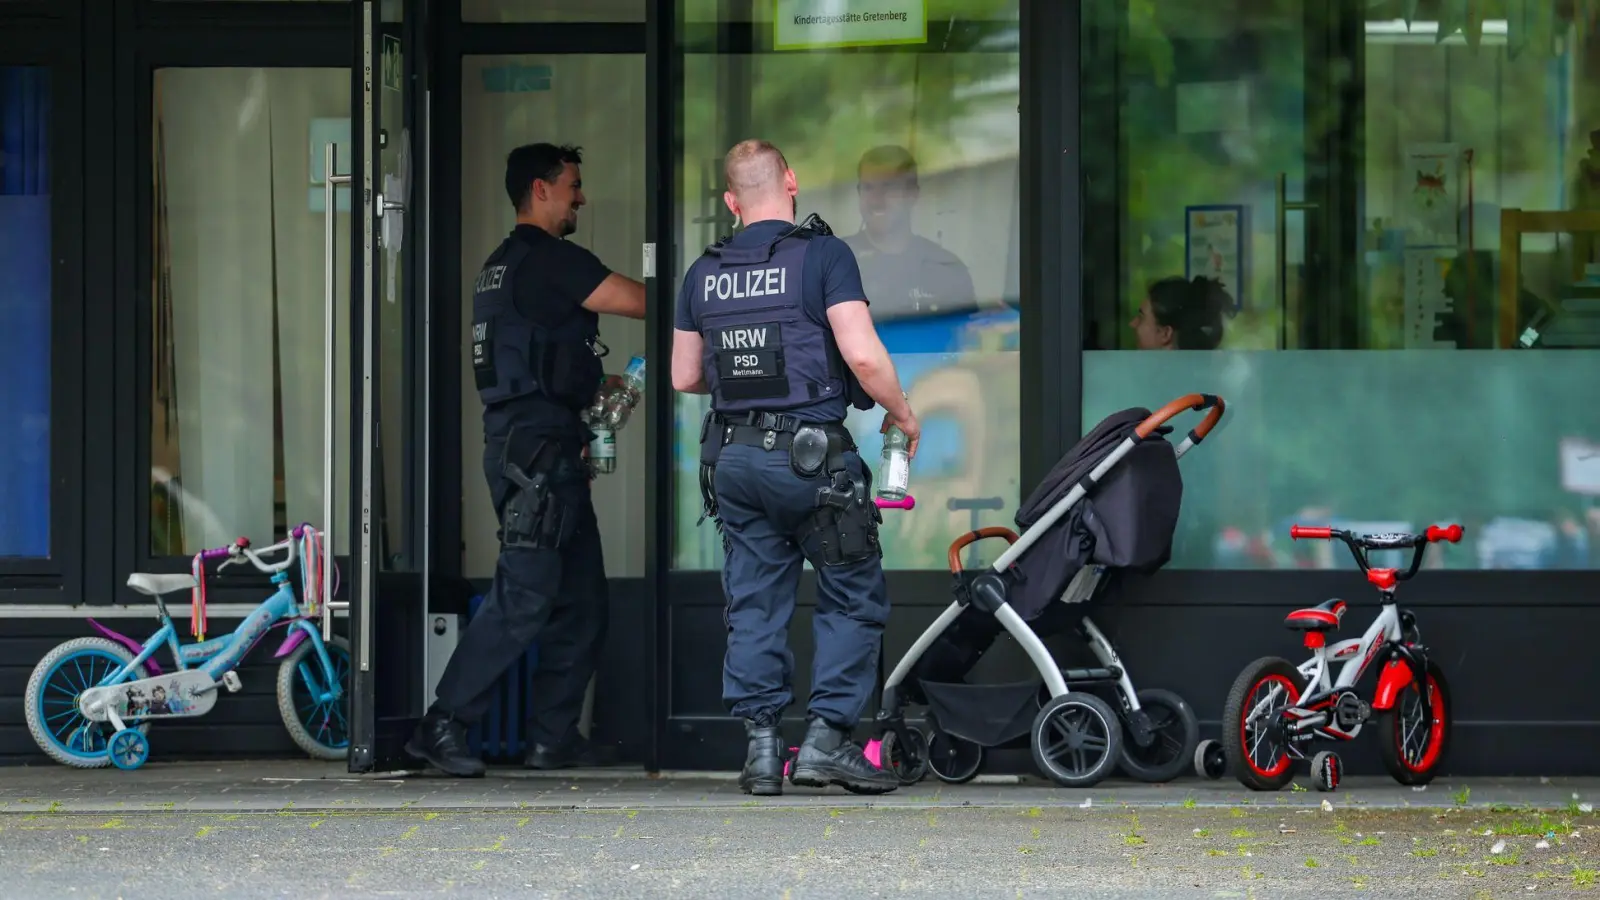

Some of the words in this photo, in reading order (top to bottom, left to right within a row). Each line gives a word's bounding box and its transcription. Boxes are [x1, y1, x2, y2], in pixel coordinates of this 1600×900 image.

[794, 12, 861, 26] Kindertagesstätte
[863, 10, 907, 22] Gretenberg
[475, 266, 507, 293] OLIZEI
[704, 267, 786, 302] POLIZEI
[721, 328, 767, 350] NRW
[733, 354, 759, 367] PSD
